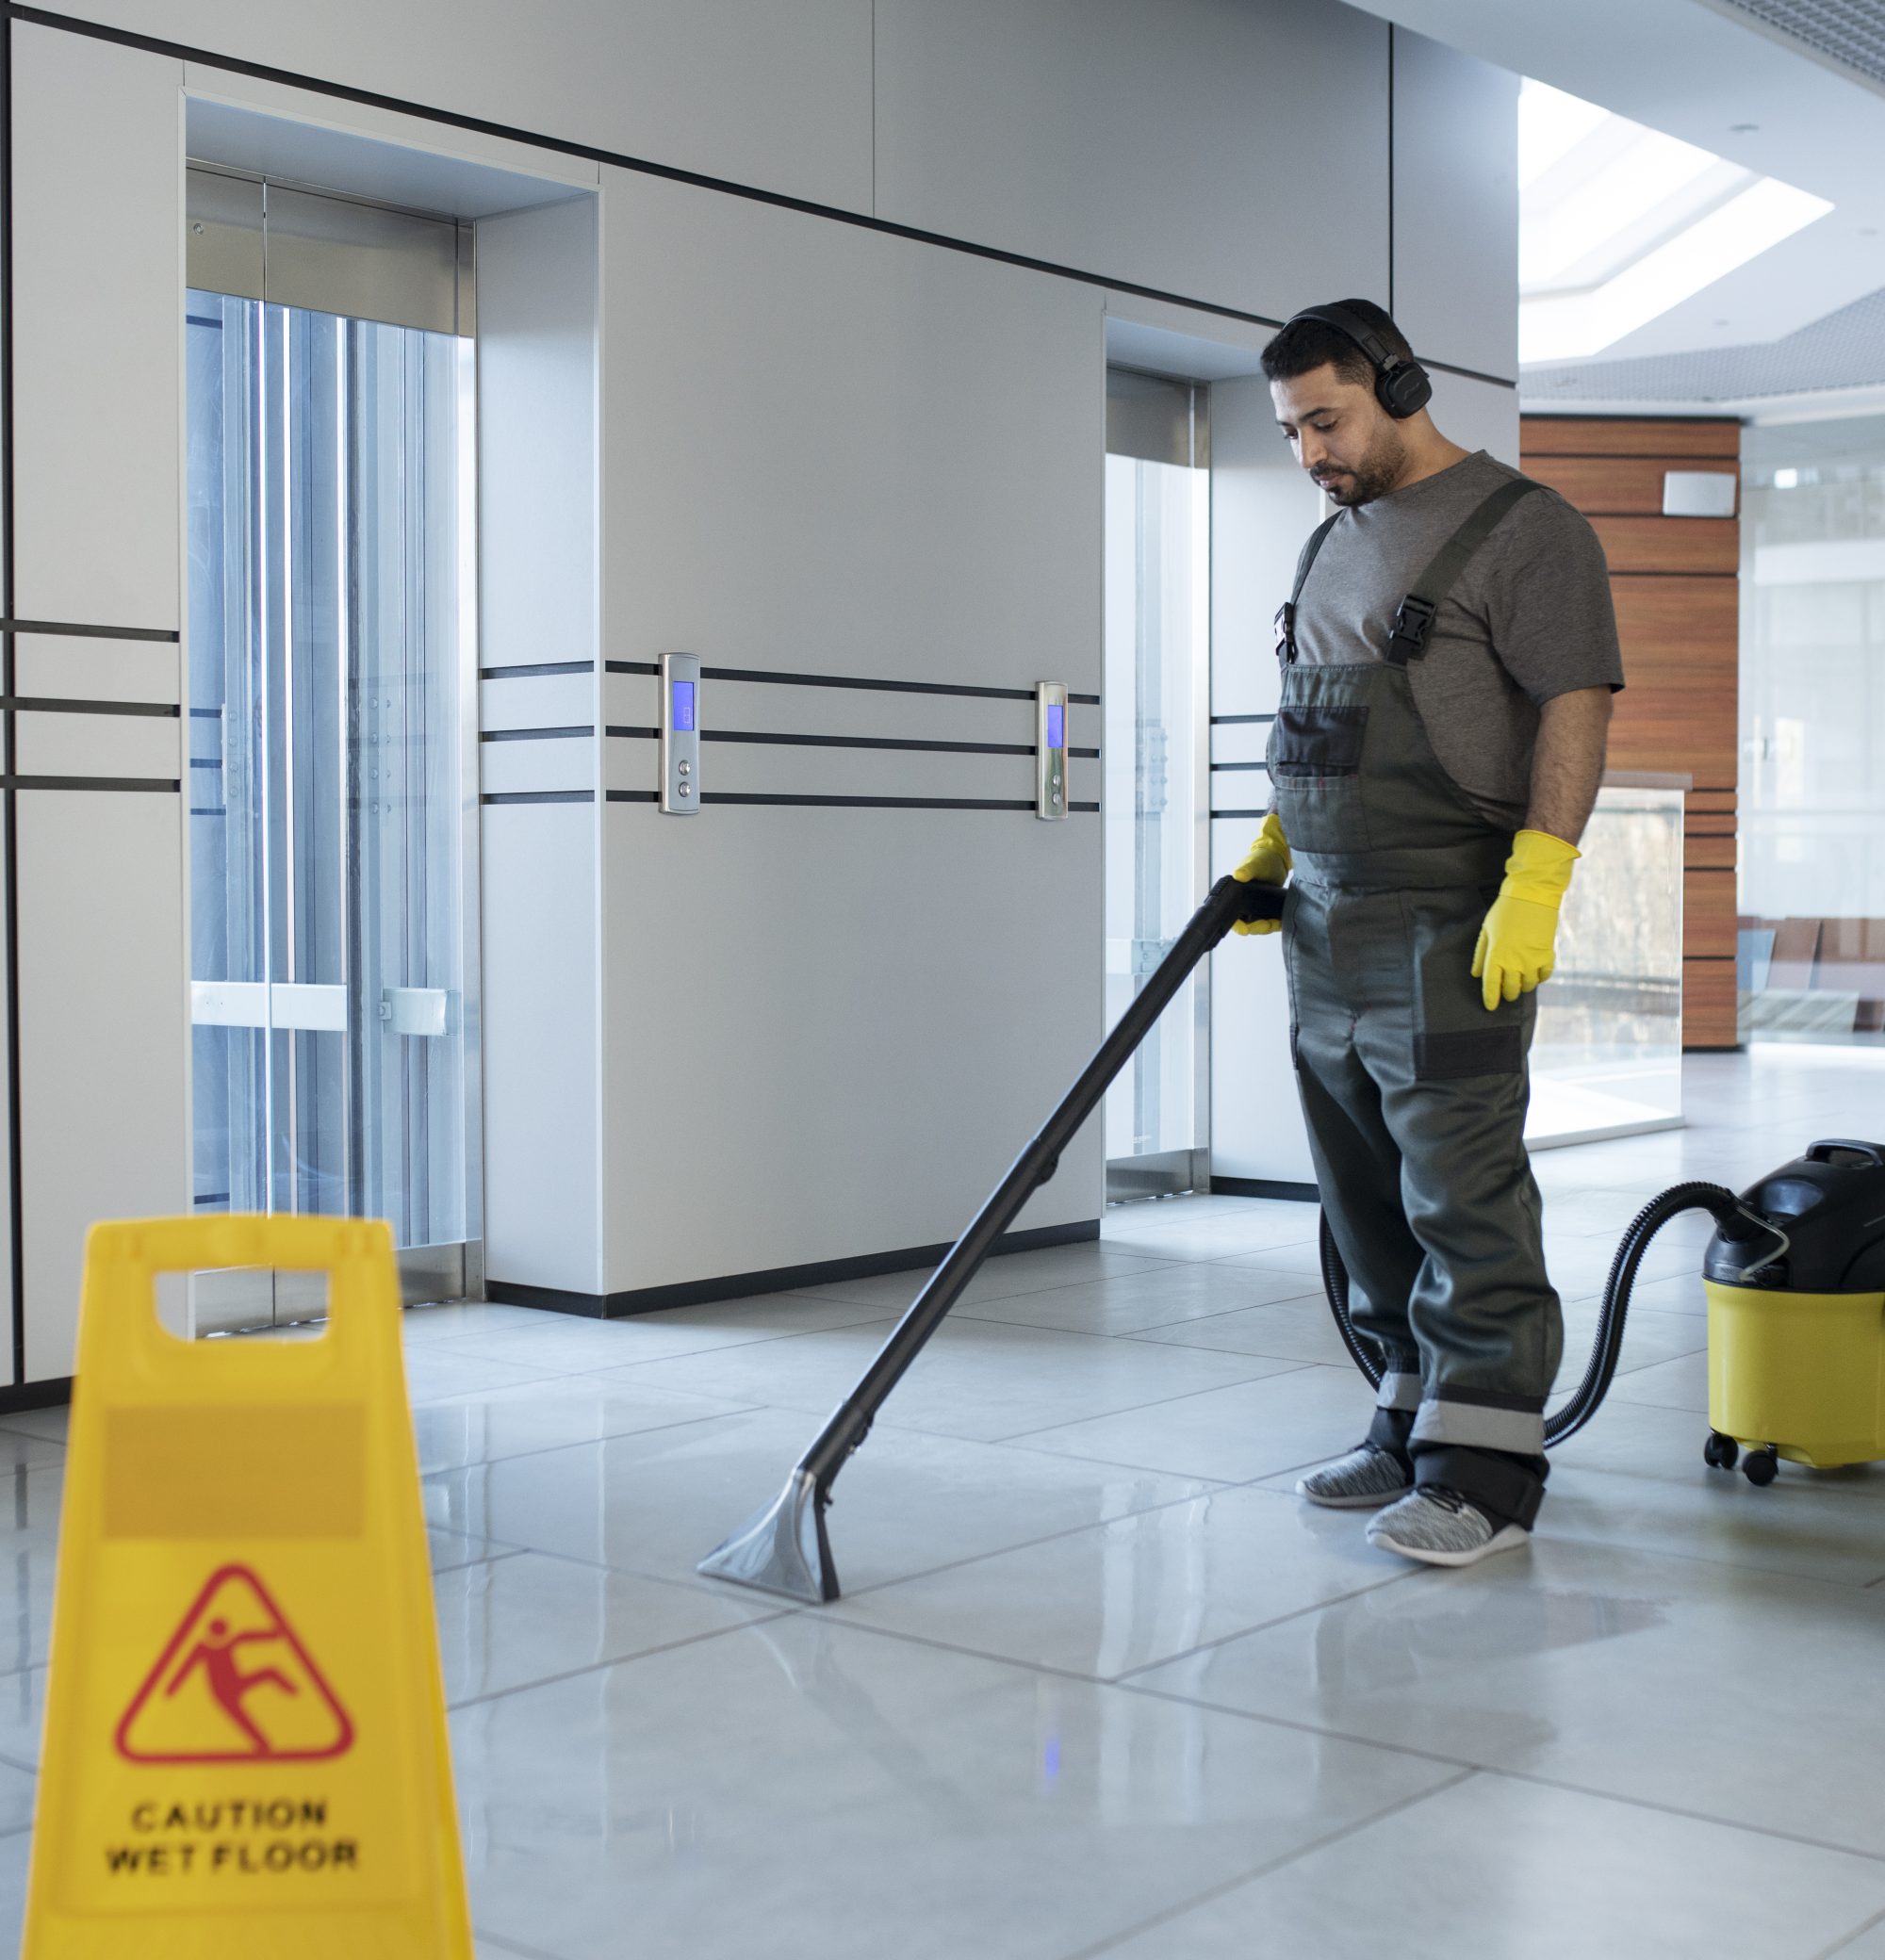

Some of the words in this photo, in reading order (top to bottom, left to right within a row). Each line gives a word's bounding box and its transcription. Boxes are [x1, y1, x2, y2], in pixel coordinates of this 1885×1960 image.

[131, 1797, 328, 1833] CAUTION
[105, 1843, 195, 1875] WET
[210, 1839, 360, 1873] FLOOR
